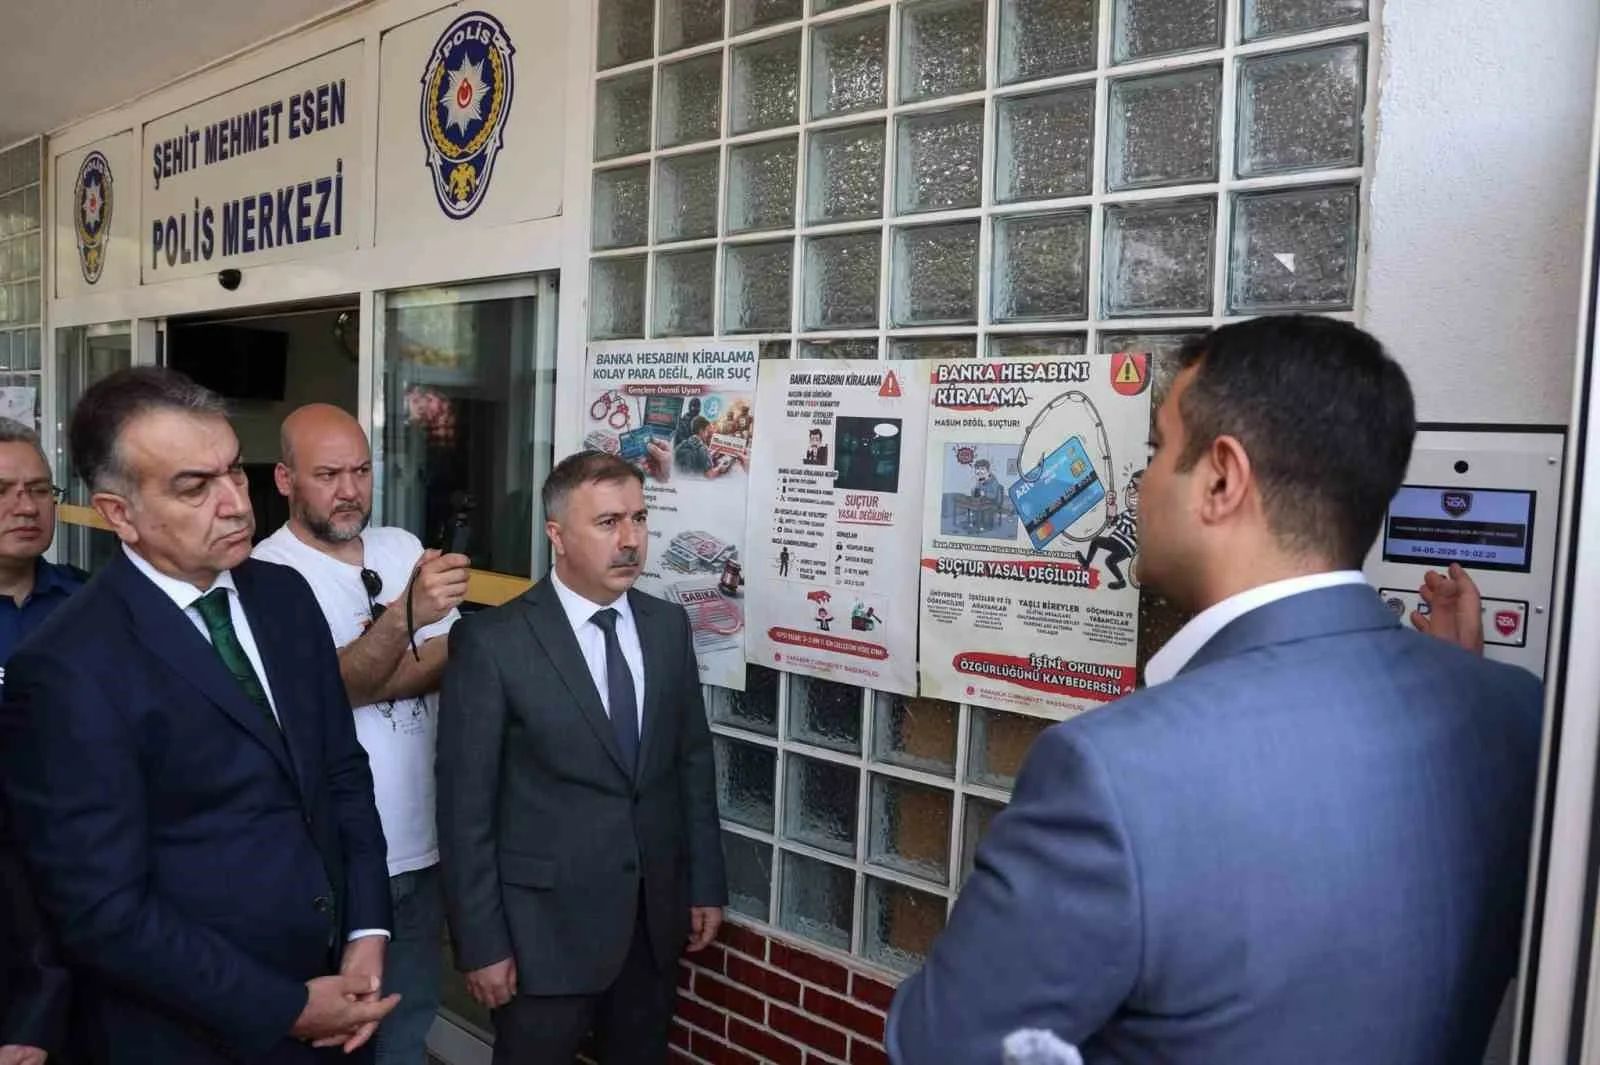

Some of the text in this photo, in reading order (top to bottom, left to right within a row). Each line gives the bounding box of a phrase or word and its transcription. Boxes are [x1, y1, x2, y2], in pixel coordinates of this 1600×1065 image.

[443, 22, 491, 58] POLİS
[153, 78, 346, 190] ŞEHİT MEHMET ESEN
[152, 158, 343, 270] POLİS MERKEZİ
[596, 349, 755, 365] BANKA HESABINI KİRALAMA
[593, 366, 752, 382] KOLAY PARA DEĞİL, AĞIR SUÇ
[789, 372, 882, 386] BANKA HESABINI KİRALAMA
[937, 362, 1090, 383] BANKA HESABINI
[936, 384, 1028, 407] KİRALAMA
[934, 419, 961, 427] MASUM
[988, 419, 1020, 429] SUÇTUR!
[845, 495, 880, 509] SUÇTUR
[838, 508, 858, 520] YASAL
[937, 558, 1090, 585] SUÇTUR YASAL DEĞİLDİR
[1018, 599, 1040, 609] YAŞLI
[1042, 600, 1080, 613] BİREYLER
[960, 658, 1121, 696] ÖZGÜRLÜĞÜNÜ KAYBEDERSİN
[1068, 662, 1122, 680] OKULUNU
